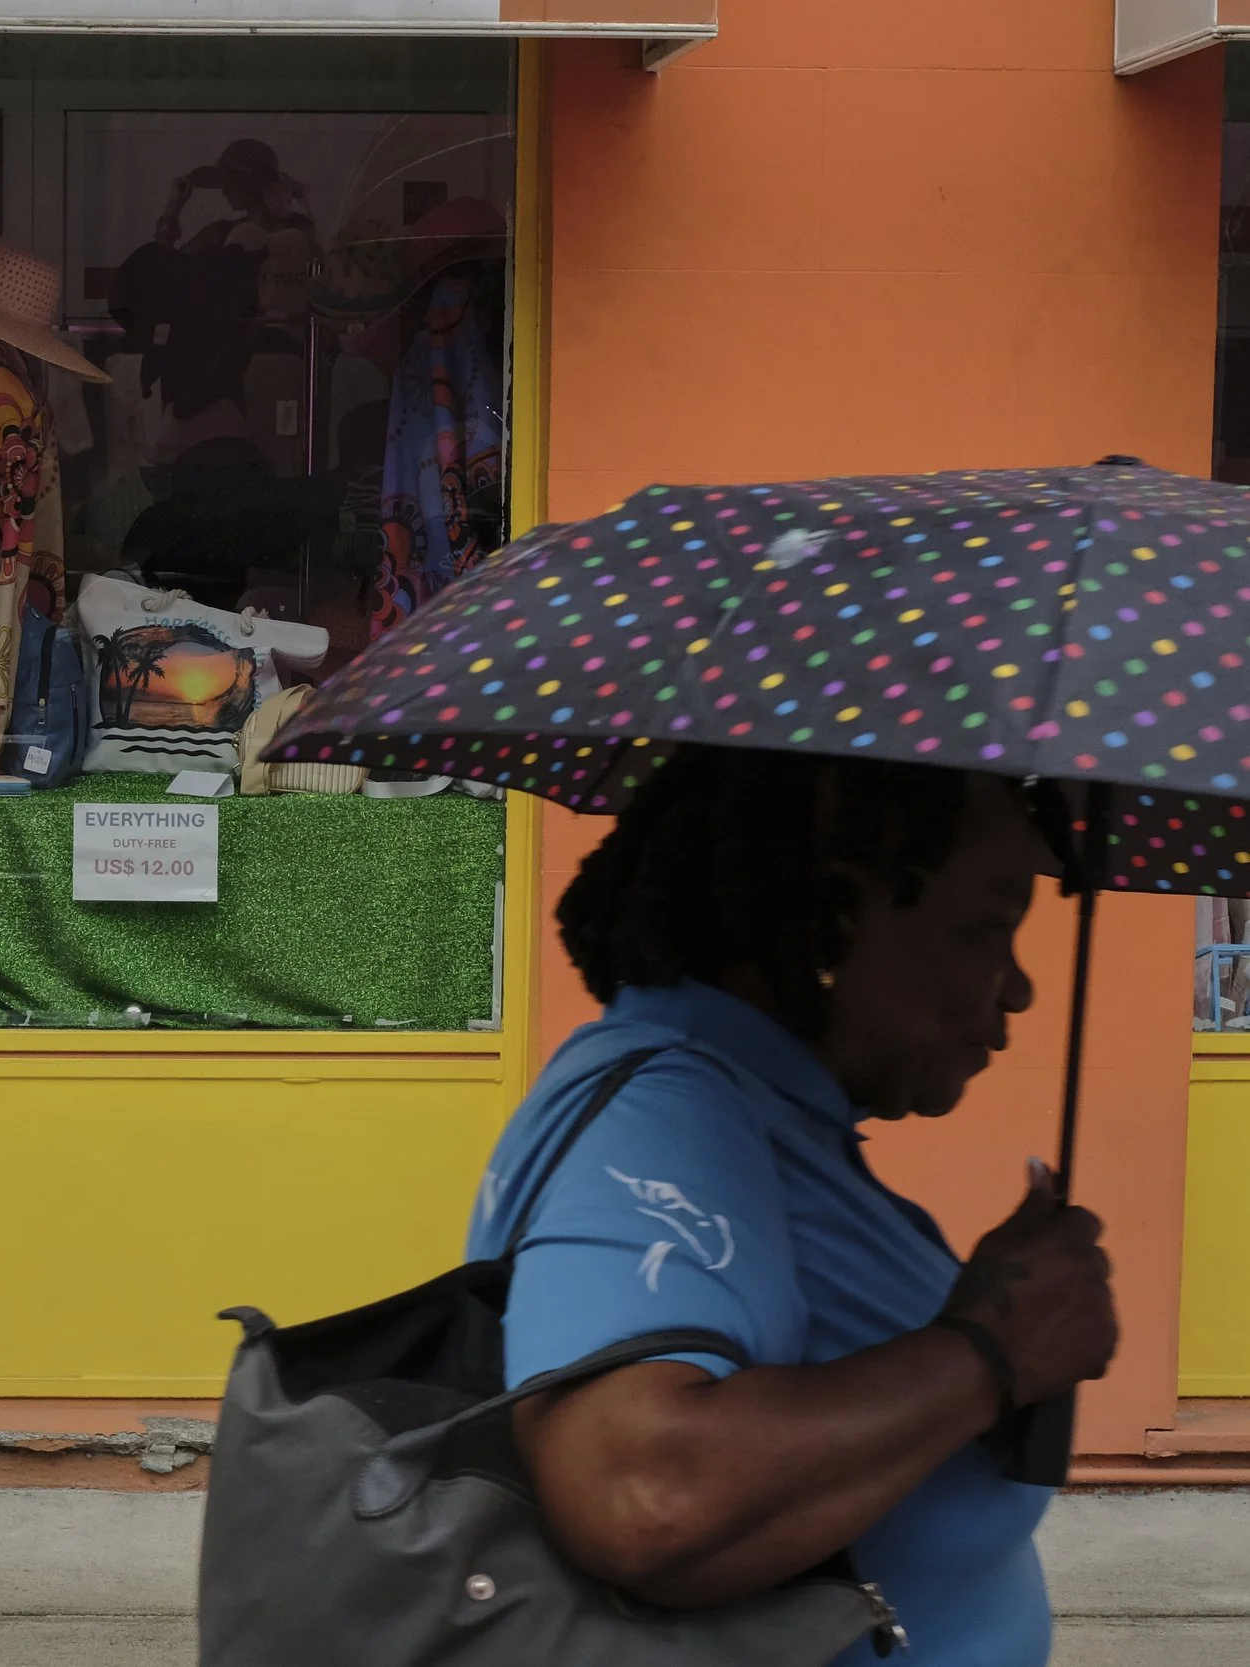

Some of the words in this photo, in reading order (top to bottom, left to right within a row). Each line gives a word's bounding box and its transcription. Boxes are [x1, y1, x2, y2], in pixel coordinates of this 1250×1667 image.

[85, 811, 206, 828] EVERYTHING
[113, 838, 177, 849] DUTY-FREE
[94, 857, 135, 876] US$
[141, 859, 195, 876] 12.00
